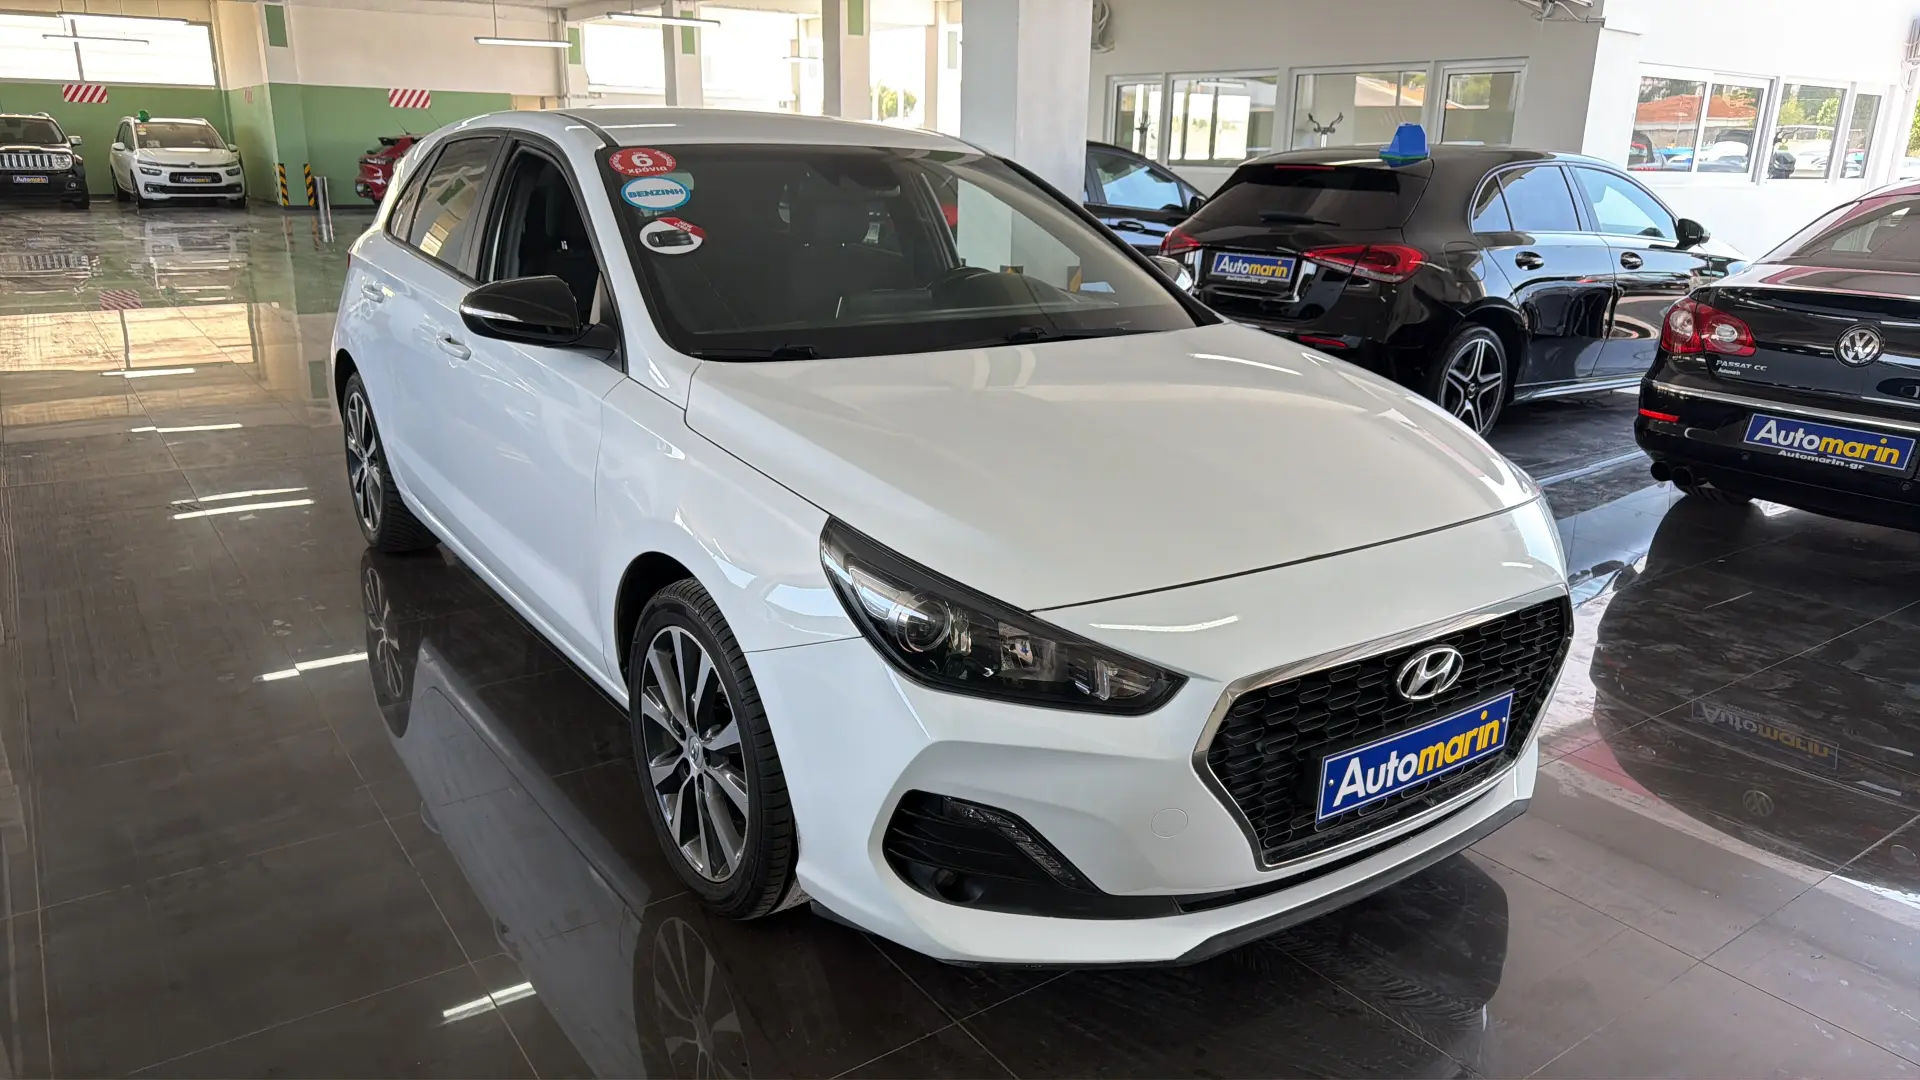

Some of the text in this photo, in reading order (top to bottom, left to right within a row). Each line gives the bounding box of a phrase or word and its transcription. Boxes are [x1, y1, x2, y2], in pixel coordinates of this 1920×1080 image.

[627, 166, 668, 174] χρόνια
[631, 153, 654, 167] 6
[1217, 255, 1288, 278] Automarin
[1715, 359, 1752, 369] PASSAT
[1754, 419, 1901, 465] Automarin
[1778, 449, 1865, 470] Automarin.gr
[1332, 710, 1500, 807] Automarin
